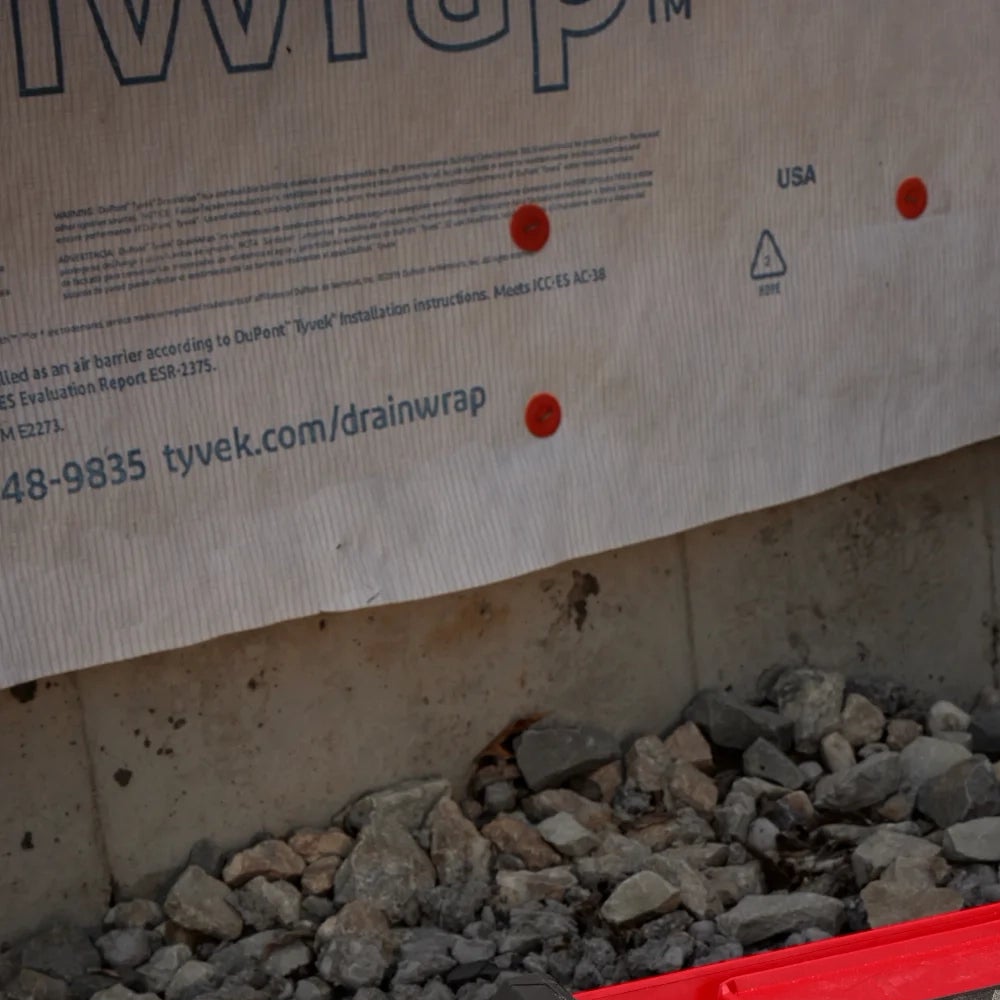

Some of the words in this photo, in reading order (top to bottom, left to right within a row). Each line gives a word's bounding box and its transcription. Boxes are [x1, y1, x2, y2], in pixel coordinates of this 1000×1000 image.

[777, 164, 817, 189] USA
[32, 365, 49, 382] as
[51, 362, 71, 378] an
[73, 356, 91, 375] air
[95, 349, 143, 370] barrier
[146, 337, 213, 361] according
[216, 334, 232, 350] to
[340, 301, 411, 327] Installation
[413, 290, 493, 313] instructions.
[493, 281, 531, 300] Meets
[533, 272, 572, 292] ICC-ES
[19, 383, 97, 407] Evaluation
[98, 370, 148, 393] Report
[149, 359, 217, 382] ESR-2375.
[1, 449, 147, 504] 48-9835
[163, 383, 488, 478] tyvek.com/drainwrap
[18, 418, 66, 440] E2273.
